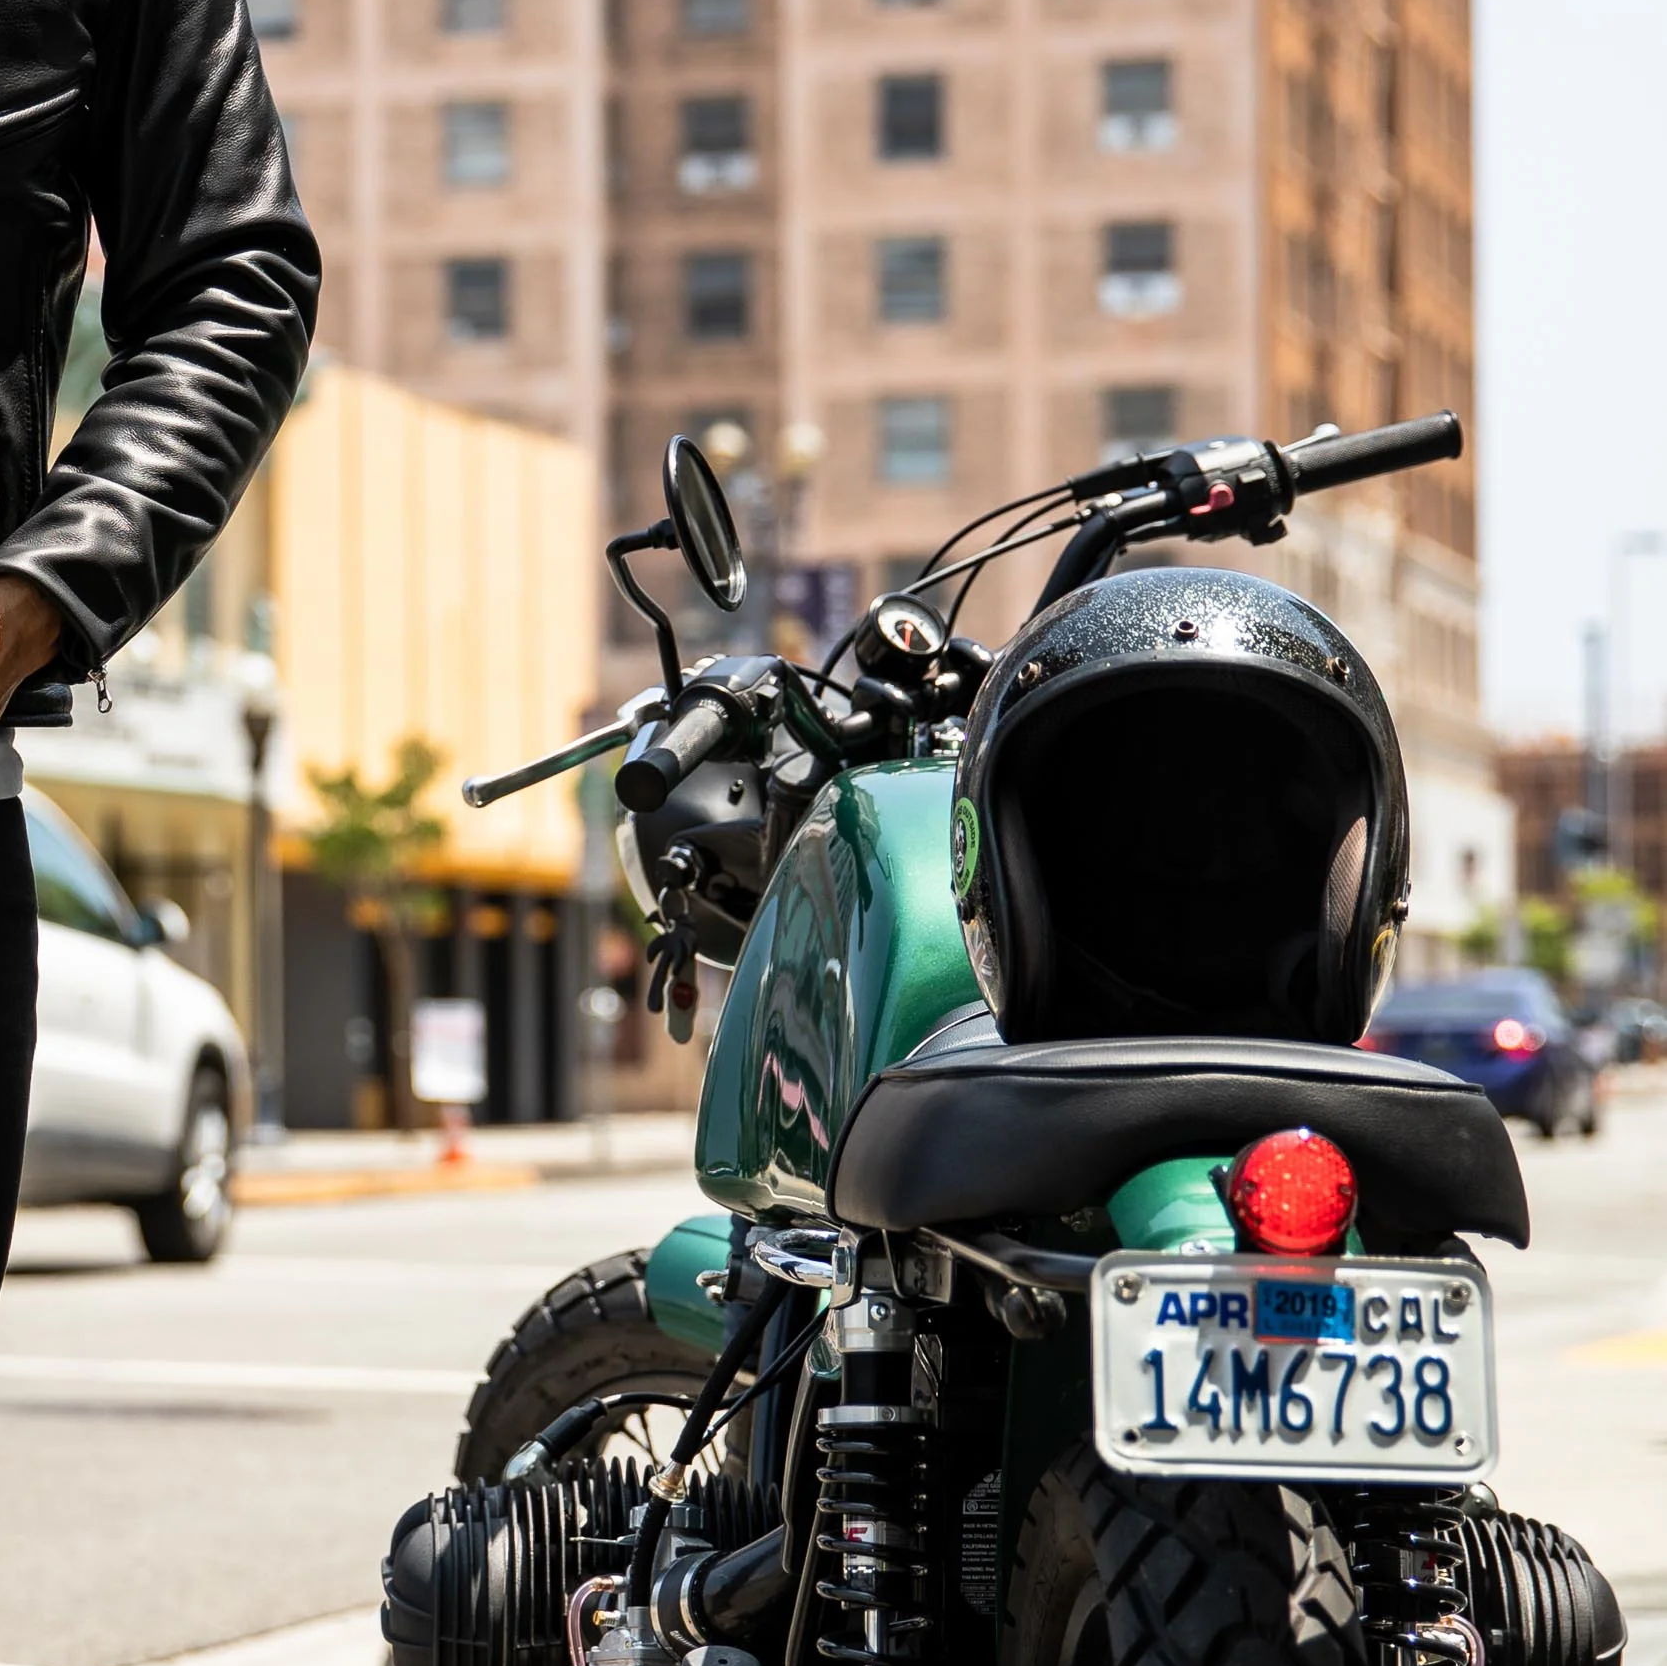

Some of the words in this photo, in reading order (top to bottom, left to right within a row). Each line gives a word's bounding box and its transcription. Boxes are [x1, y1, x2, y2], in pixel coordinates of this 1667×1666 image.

[1157, 1291, 1249, 1329] APR
[1274, 1289, 1337, 1318] 2019
[1363, 1295, 1459, 1340] CAL
[1142, 1348, 1453, 1437] 14M6738
